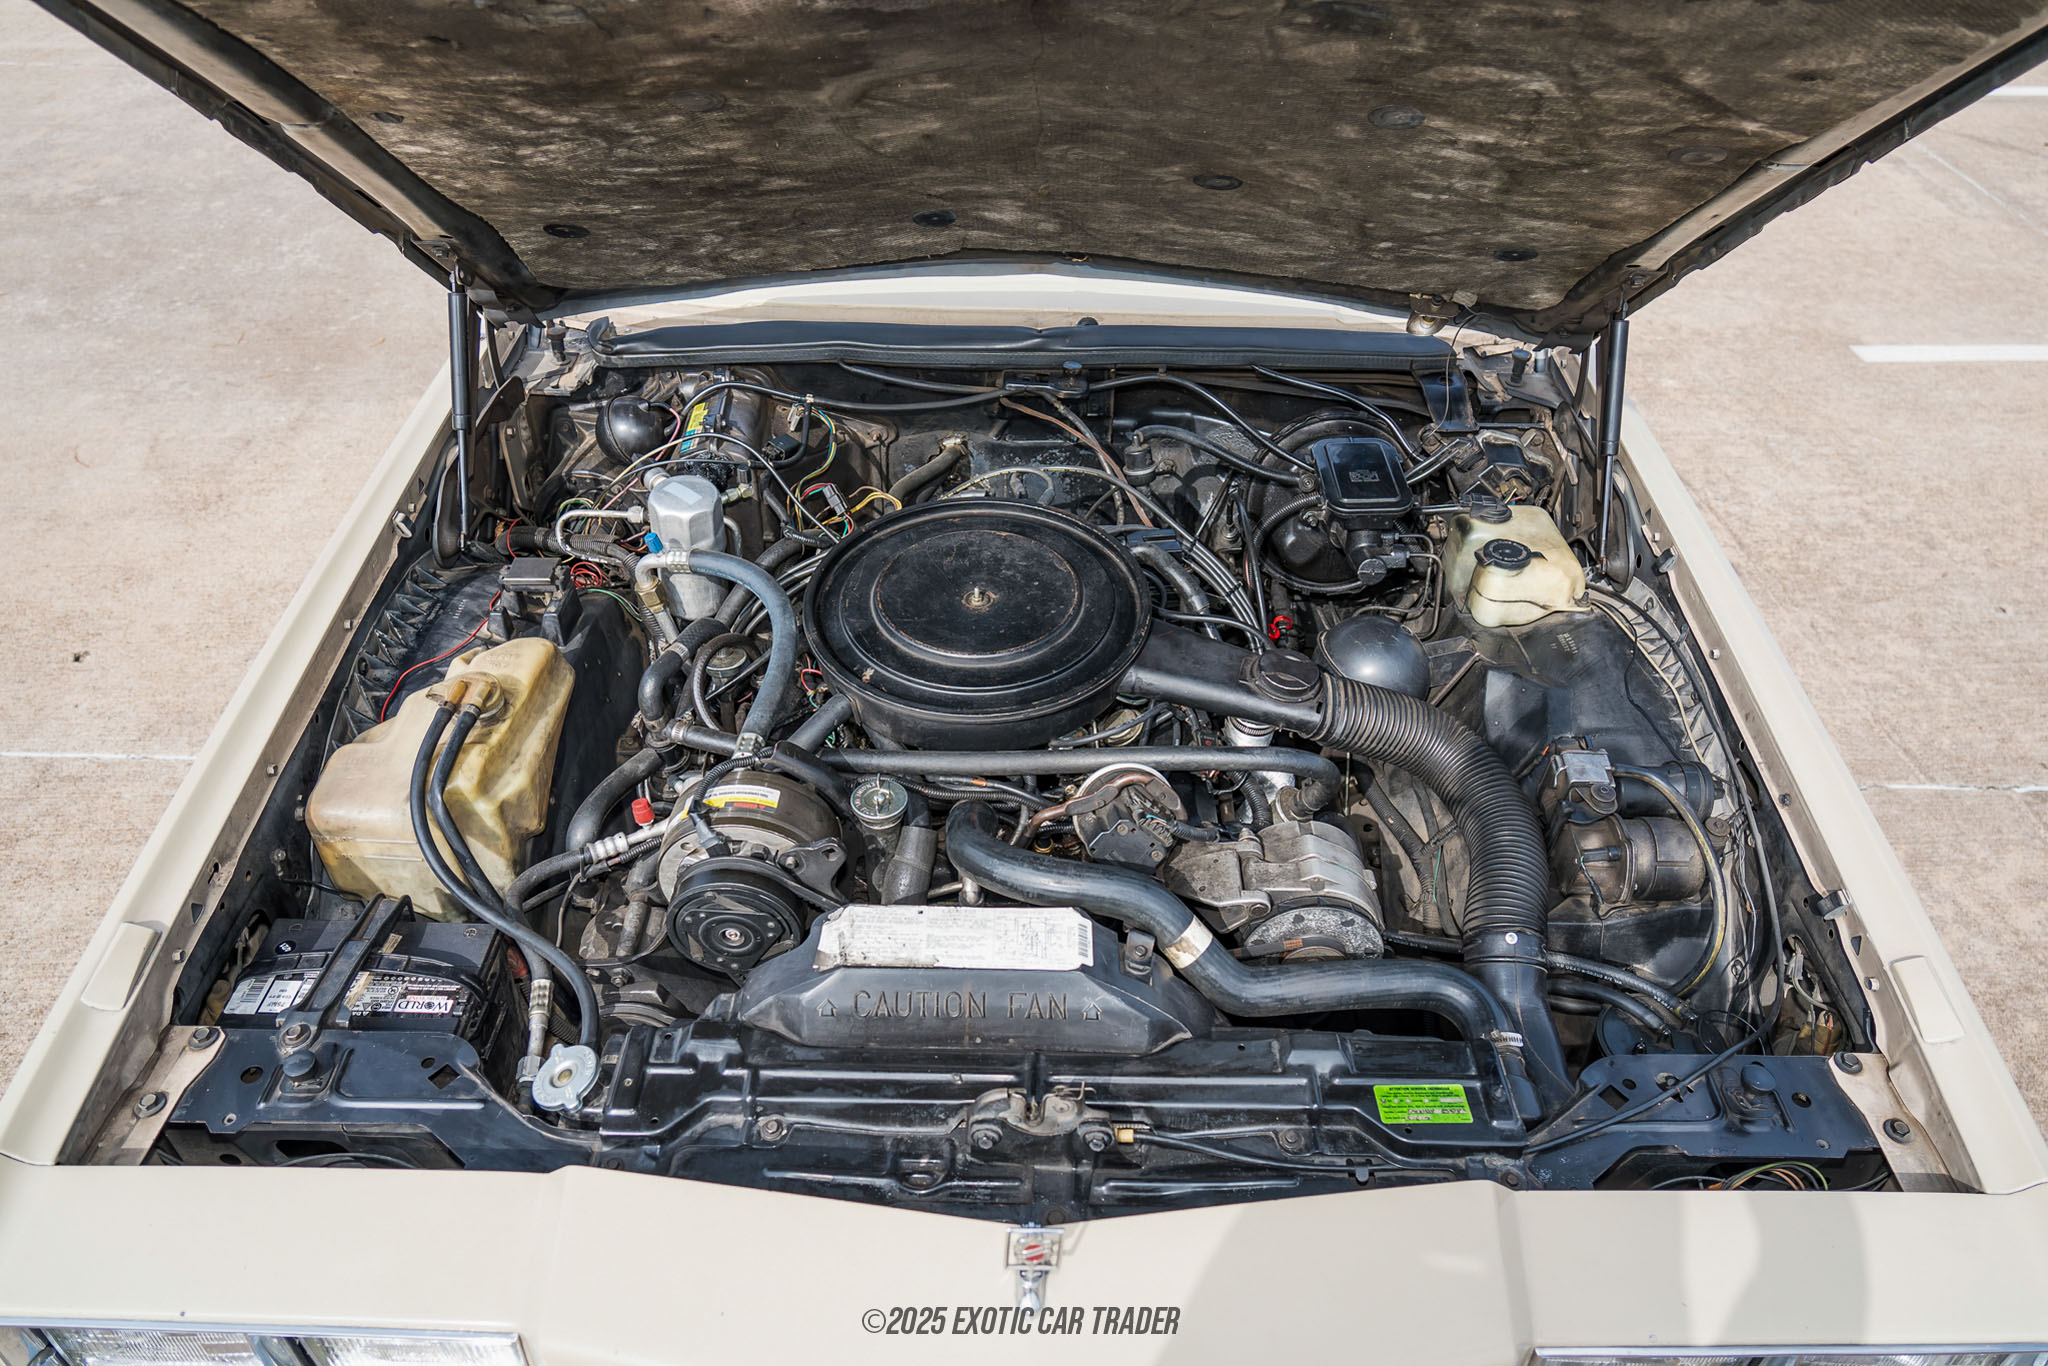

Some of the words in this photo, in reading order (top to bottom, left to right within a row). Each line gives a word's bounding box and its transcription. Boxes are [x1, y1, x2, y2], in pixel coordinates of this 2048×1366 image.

[397, 1000, 448, 1011] WORLD
[853, 991, 987, 1019] CAUTION
[1007, 992, 1069, 1020] FAN
